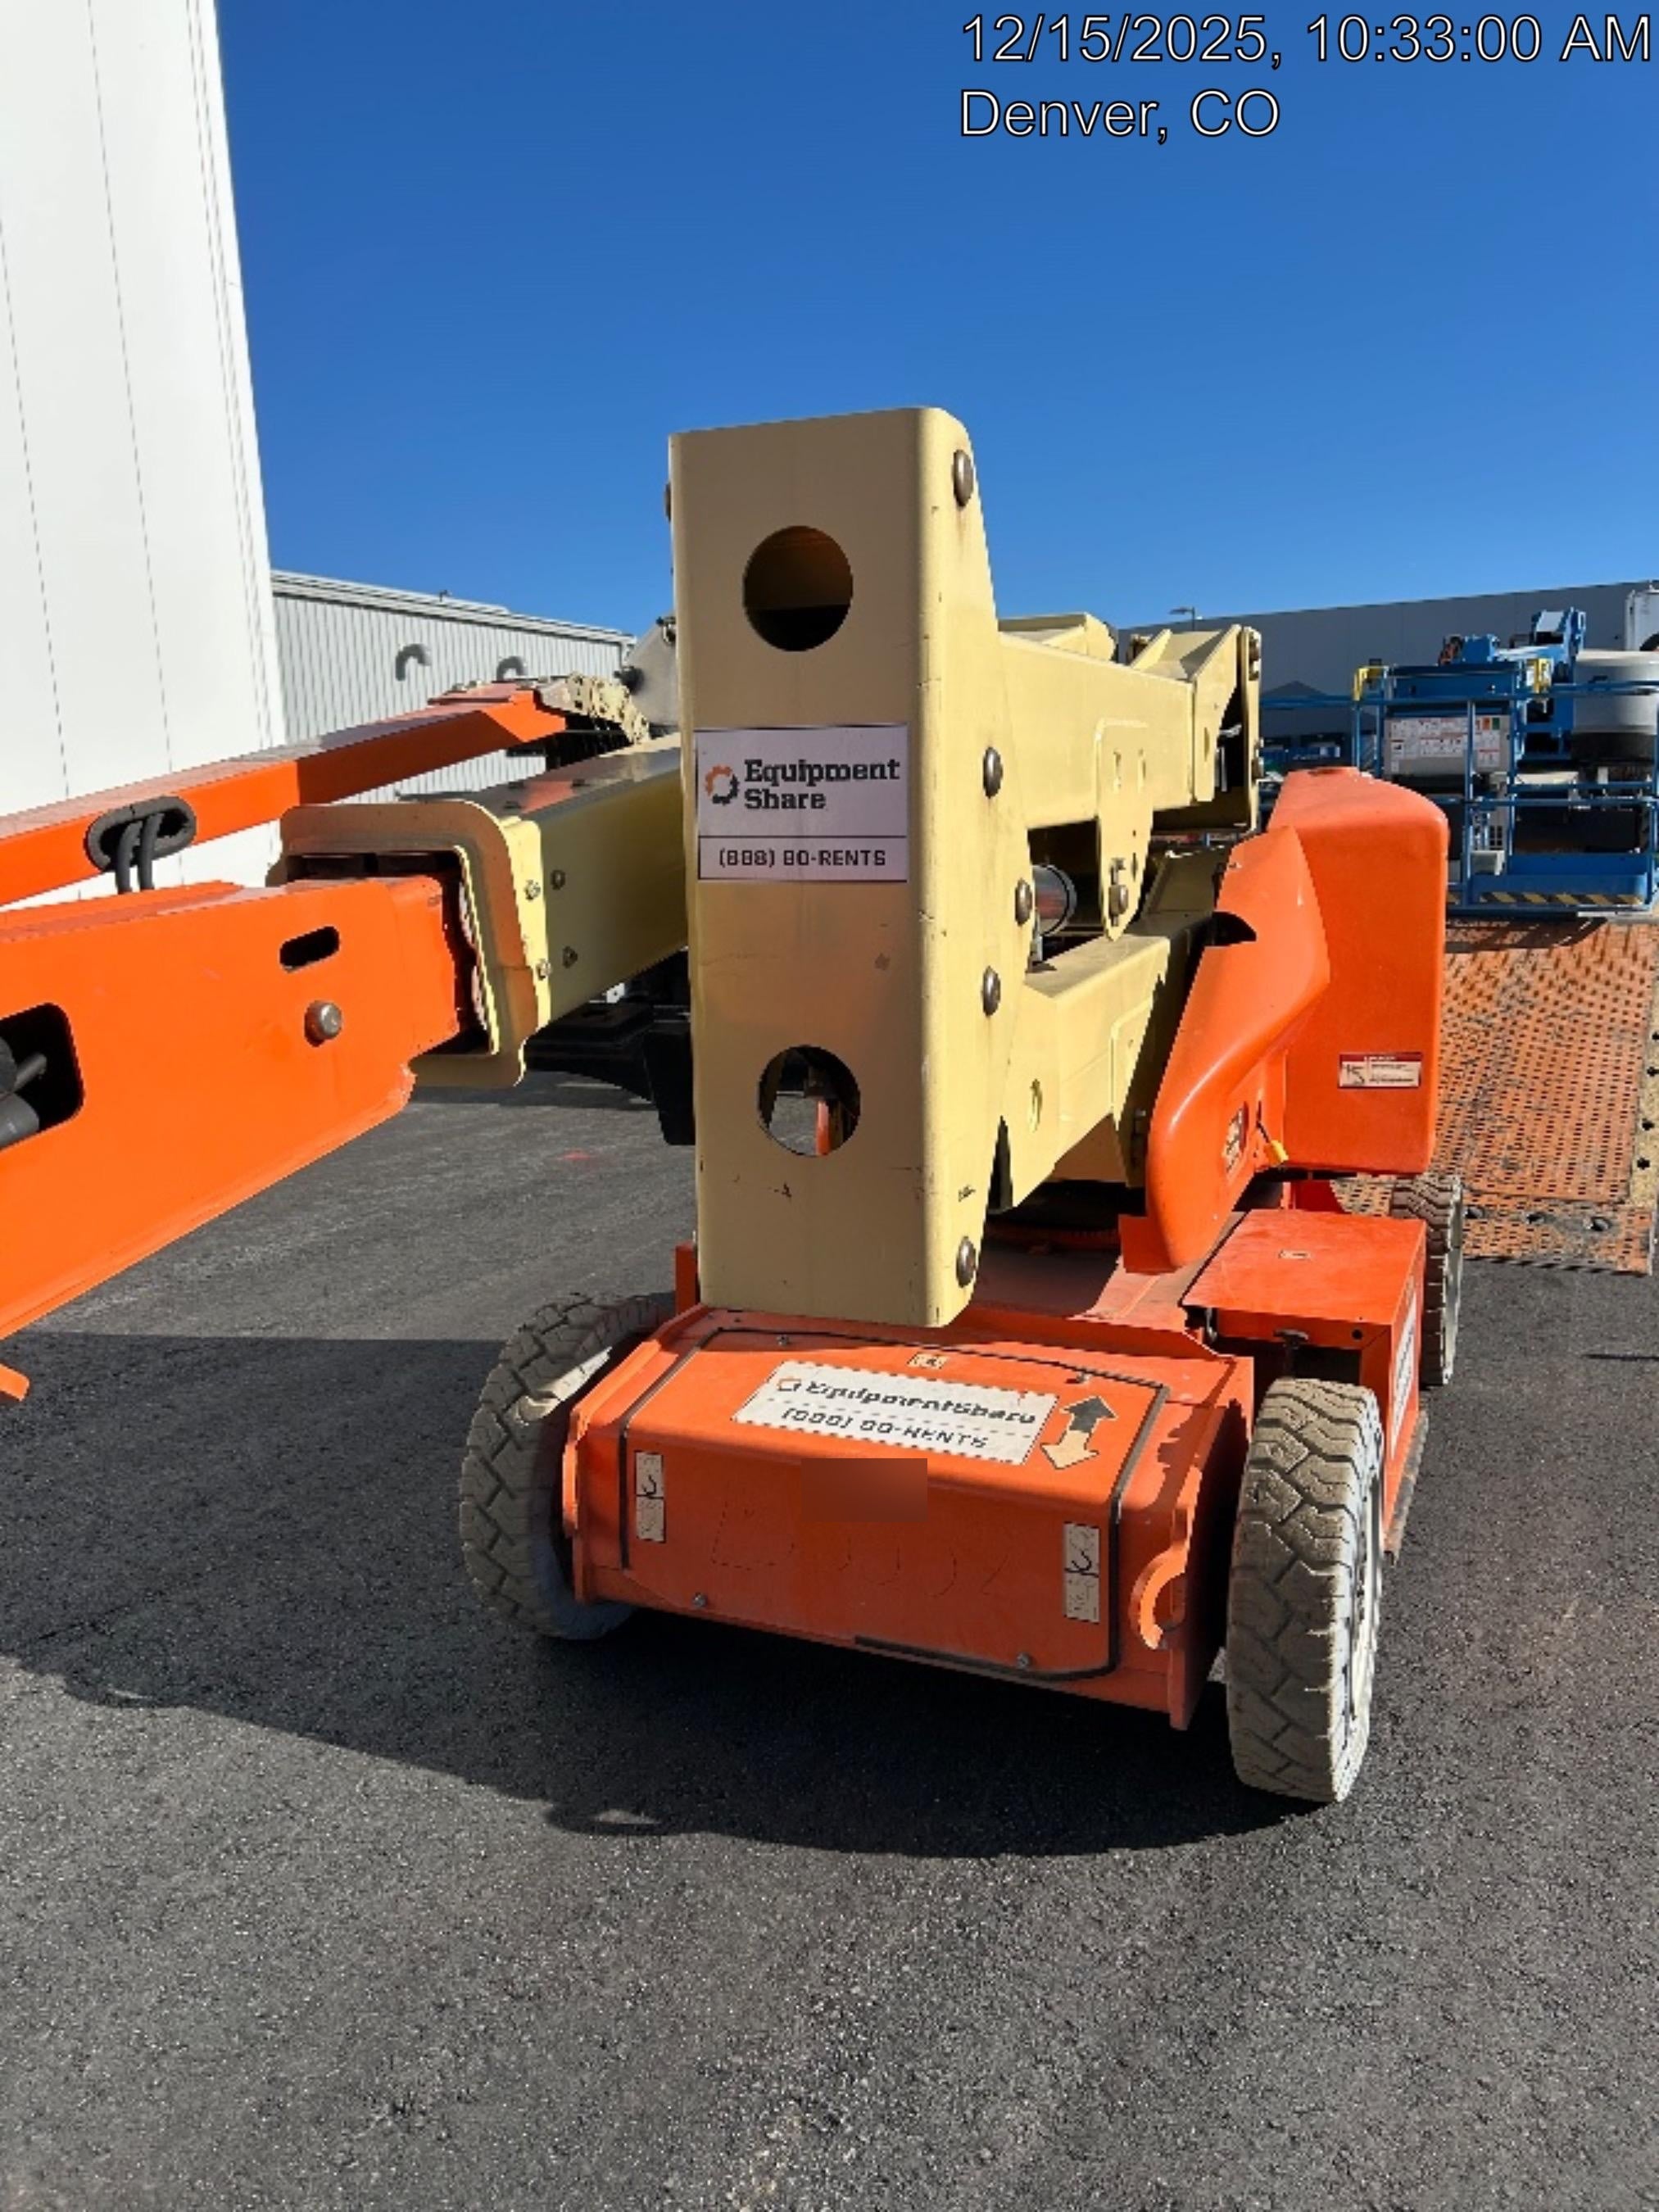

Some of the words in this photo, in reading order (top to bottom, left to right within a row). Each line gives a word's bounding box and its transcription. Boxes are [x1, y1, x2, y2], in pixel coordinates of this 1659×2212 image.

[745, 759, 900, 786] Equipment
[745, 789, 826, 809] Share
[719, 848, 775, 868] (888)
[783, 850, 886, 866] 80-RENTS
